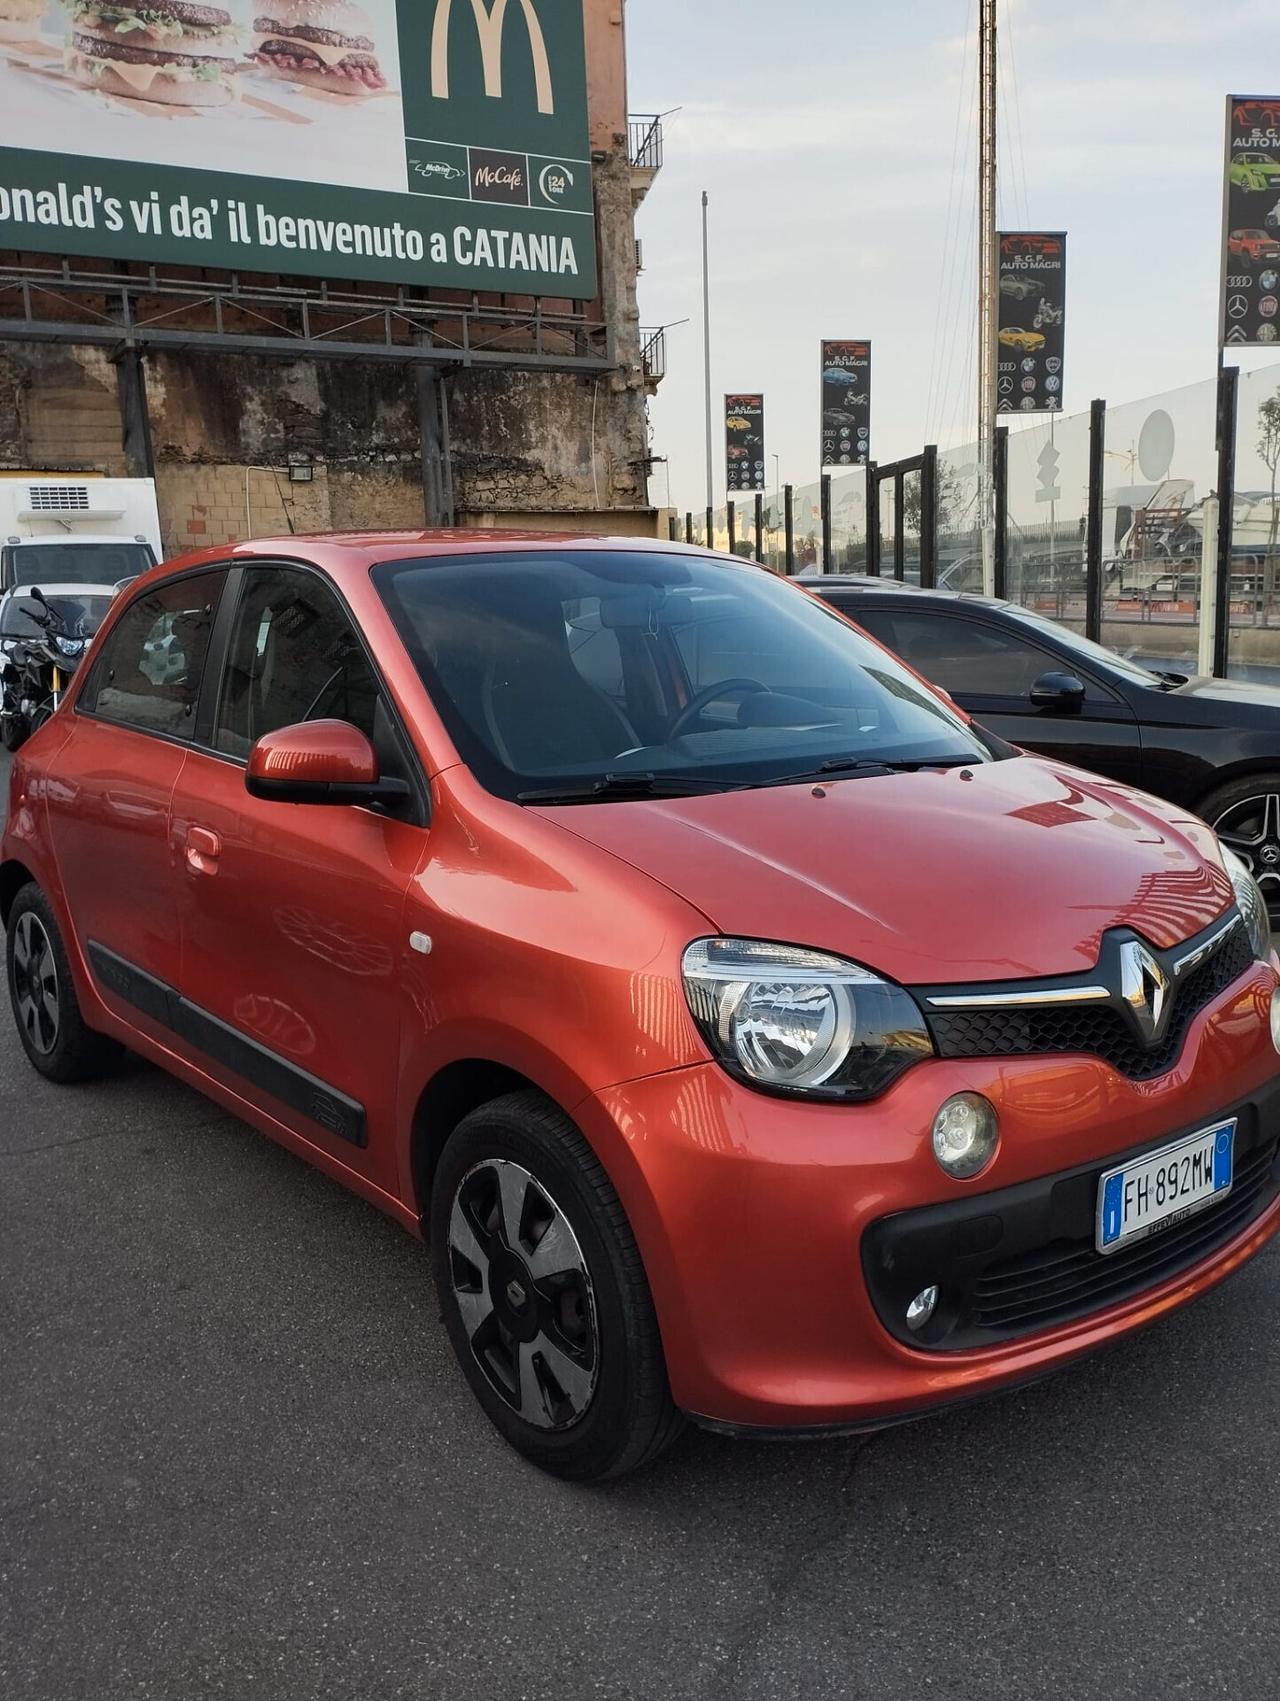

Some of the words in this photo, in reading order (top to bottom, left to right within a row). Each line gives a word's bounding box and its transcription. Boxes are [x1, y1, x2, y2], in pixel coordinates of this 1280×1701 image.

[1233, 137, 1270, 147] AUTO
[475, 166, 522, 190] McCafé
[551, 176, 565, 188] 24
[130, 192, 161, 235] vi
[228, 200, 252, 244] il
[257, 204, 424, 261] benvenuto
[430, 232, 448, 263] a
[454, 226, 579, 275] CATANIA
[1000, 262, 1029, 270] AUTO
[1030, 261, 1061, 270] MAGRI
